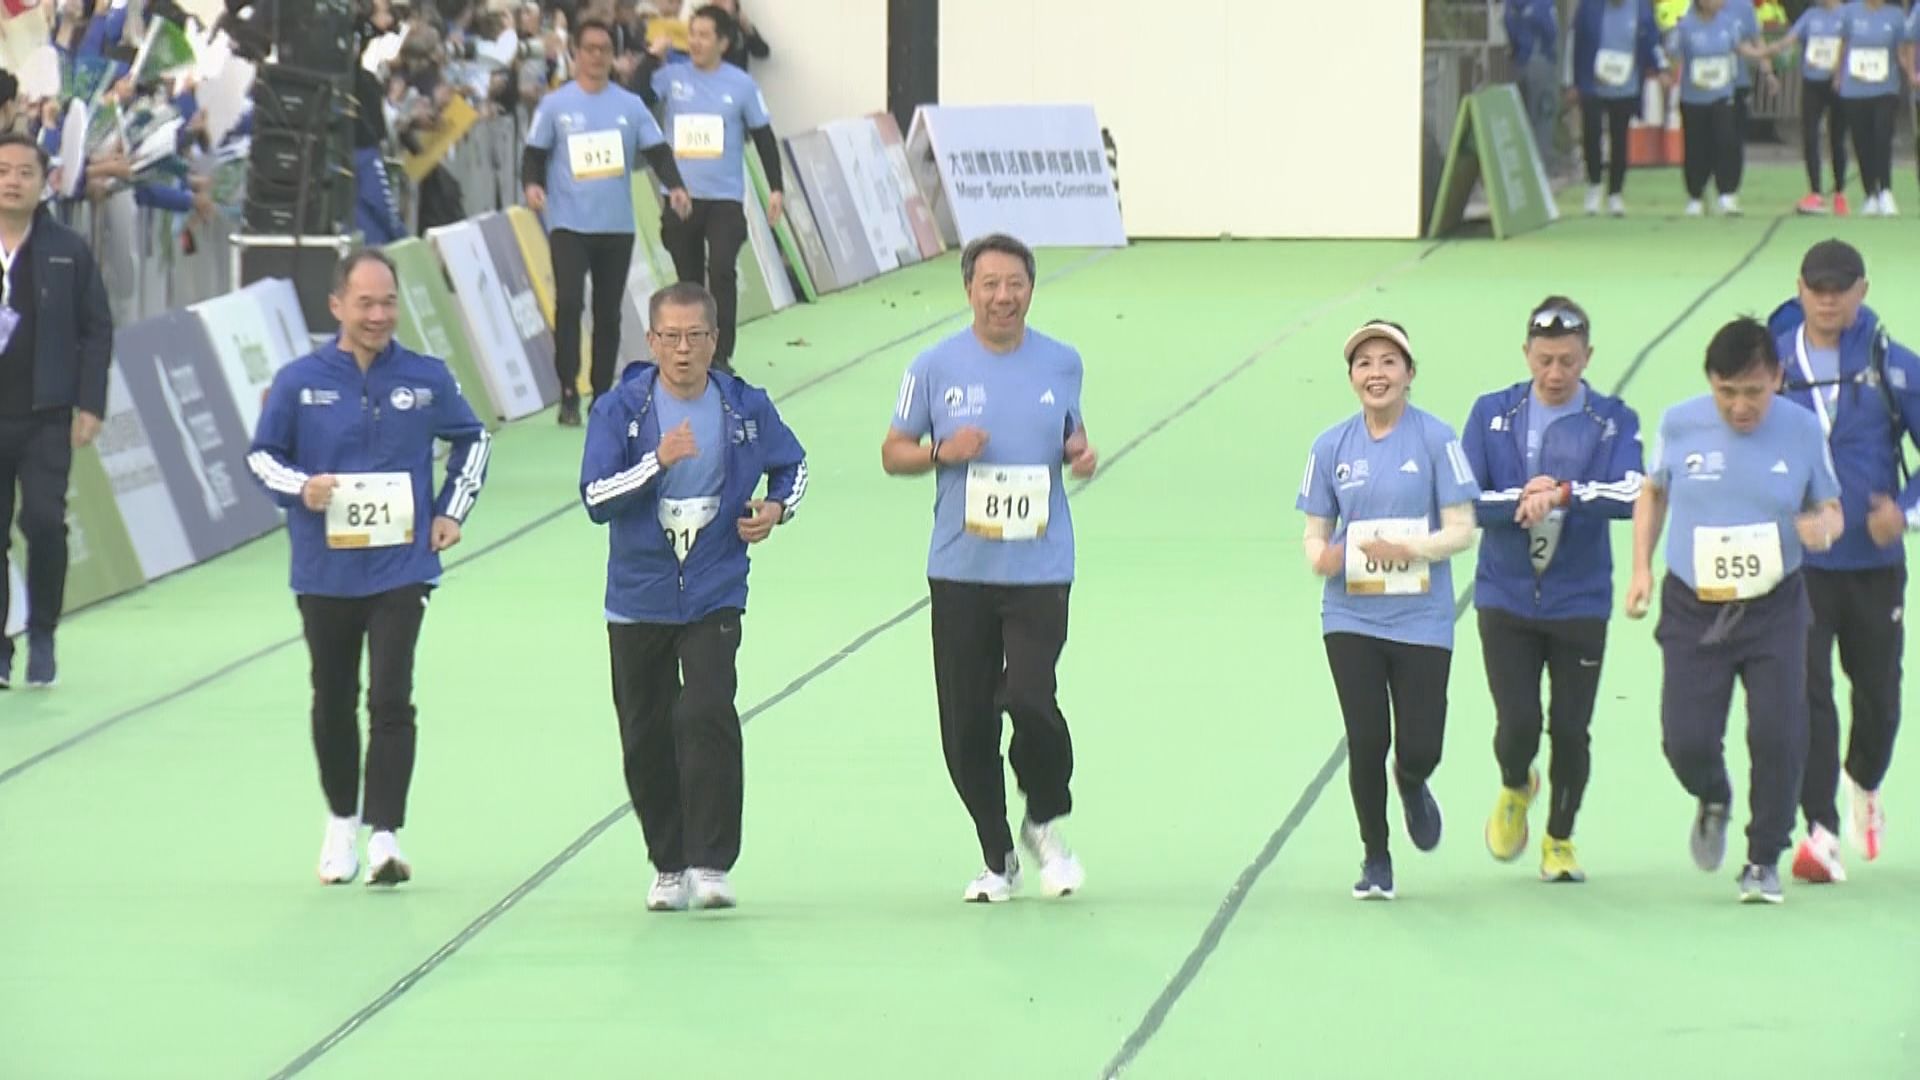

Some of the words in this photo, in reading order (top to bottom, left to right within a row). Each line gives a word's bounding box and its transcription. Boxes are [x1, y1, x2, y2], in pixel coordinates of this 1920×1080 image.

[584, 149, 612, 167] 912
[955, 180, 985, 202] Major
[986, 180, 1021, 202] Sports
[1020, 180, 1055, 198] Events
[1055, 181, 1108, 198] Committee
[347, 501, 392, 527] 821
[986, 494, 1030, 519] 810
[1715, 554, 1761, 579] 859
